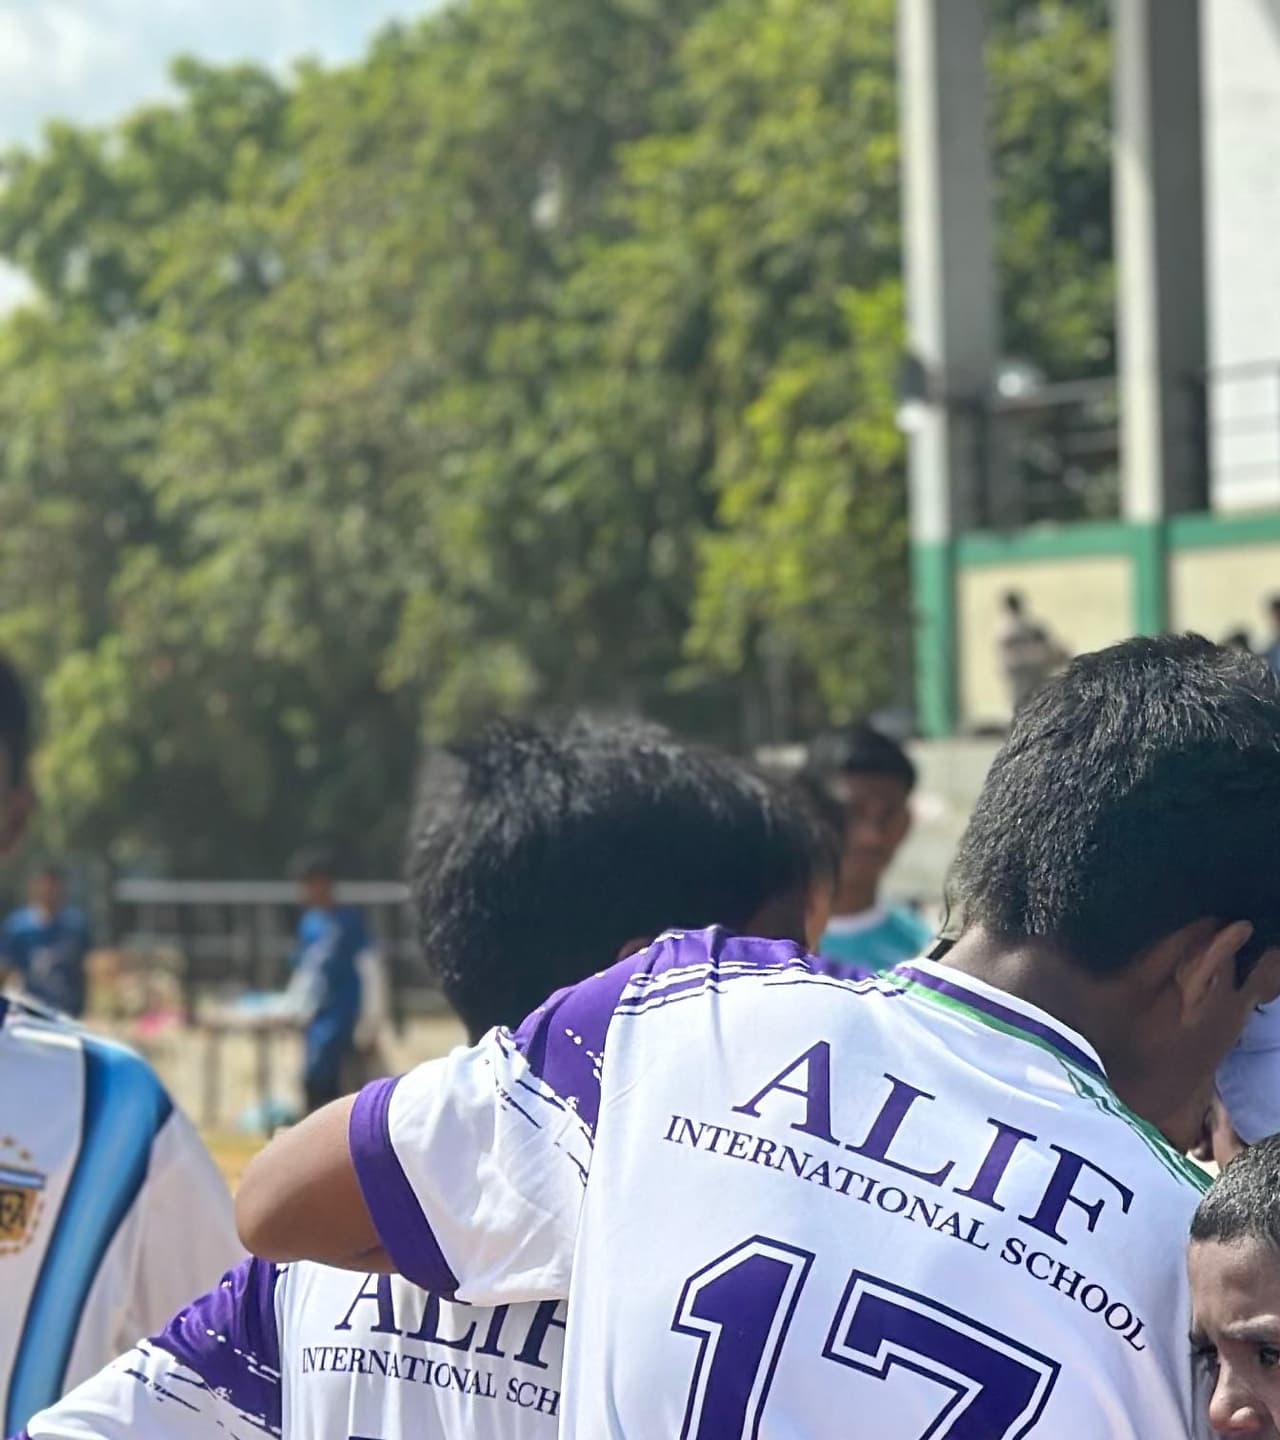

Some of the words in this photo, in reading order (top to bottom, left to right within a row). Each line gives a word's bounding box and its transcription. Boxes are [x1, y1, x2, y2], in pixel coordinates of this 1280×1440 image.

[662, 1114, 990, 1252] INTERNATIONAL
[999, 1235, 1148, 1353] SCHOOL
[731, 1040, 1135, 1247] ALIF
[302, 1346, 498, 1399] INTERNATIONAL
[506, 1376, 561, 1416] SCH
